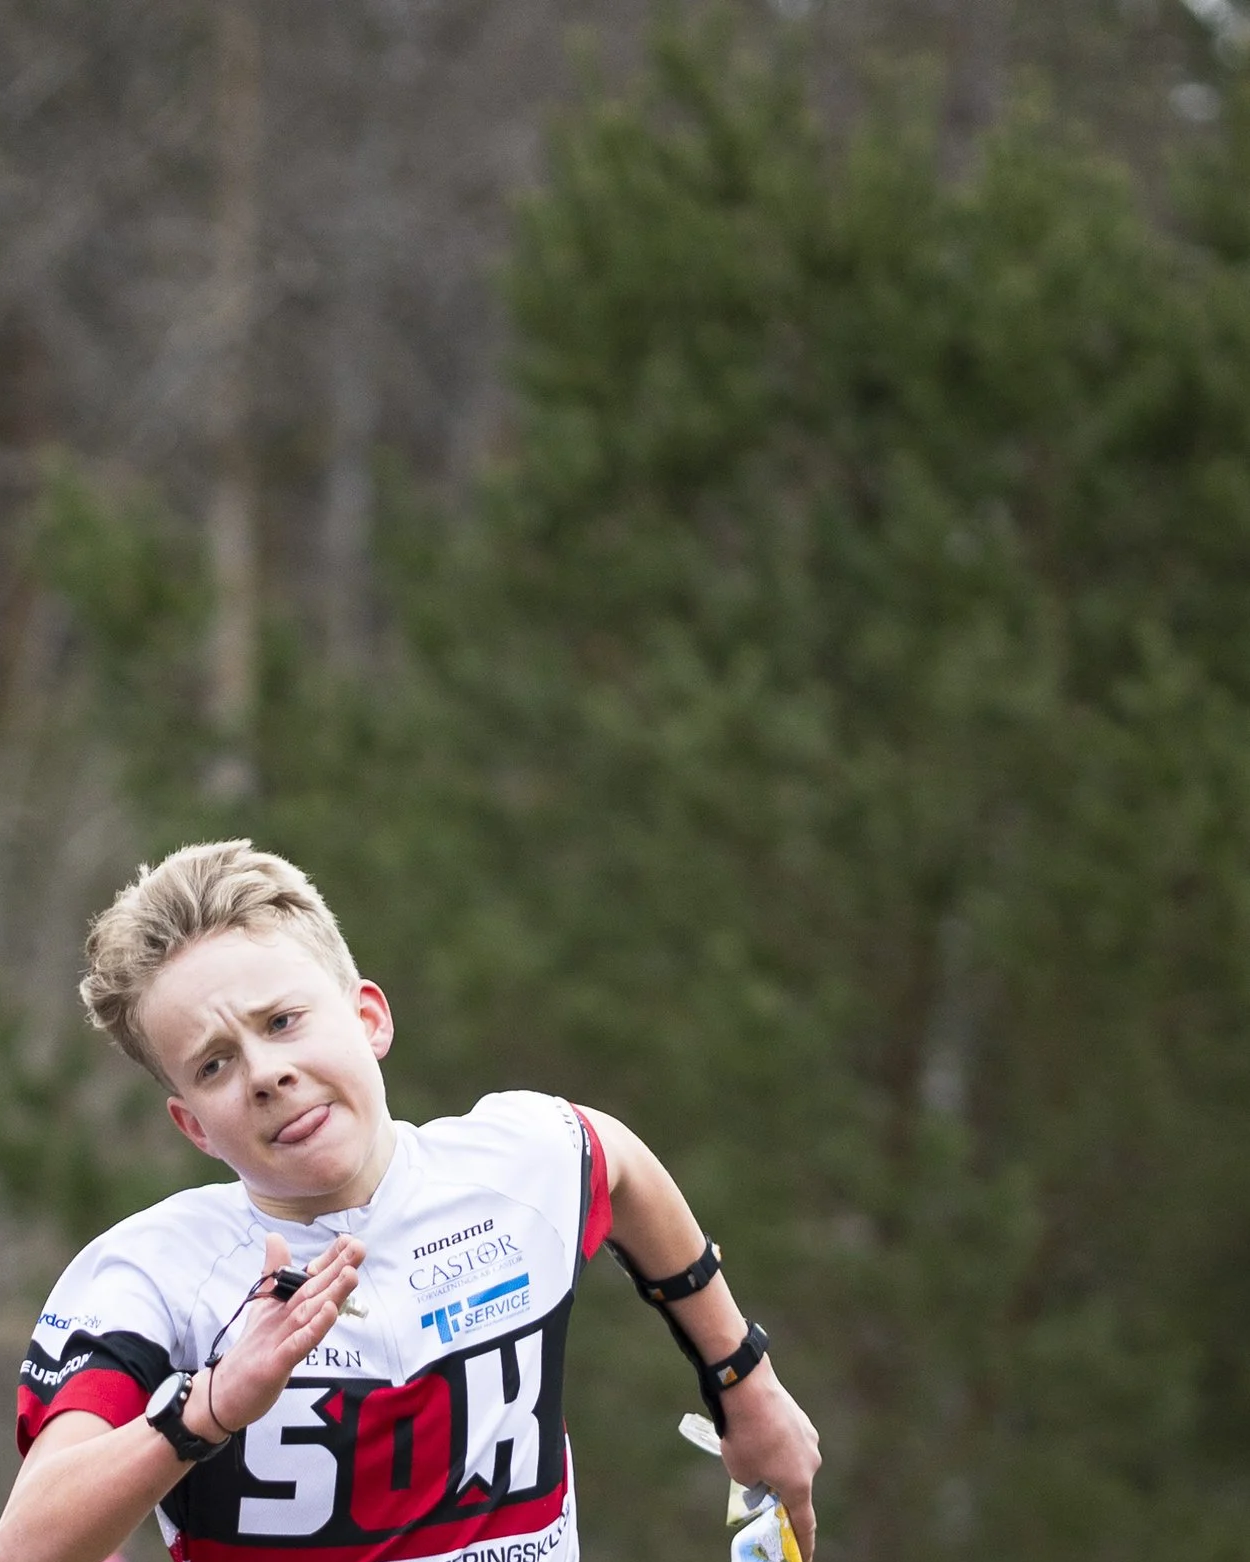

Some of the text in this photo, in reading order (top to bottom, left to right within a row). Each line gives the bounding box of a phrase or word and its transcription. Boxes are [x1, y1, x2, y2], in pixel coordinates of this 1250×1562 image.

[412, 1218, 495, 1260] noname
[408, 1233, 519, 1291] CASTOR
[464, 1289, 530, 1328] SERVICE
[305, 1346, 362, 1368] ERN
[237, 1328, 543, 1537] SOK
